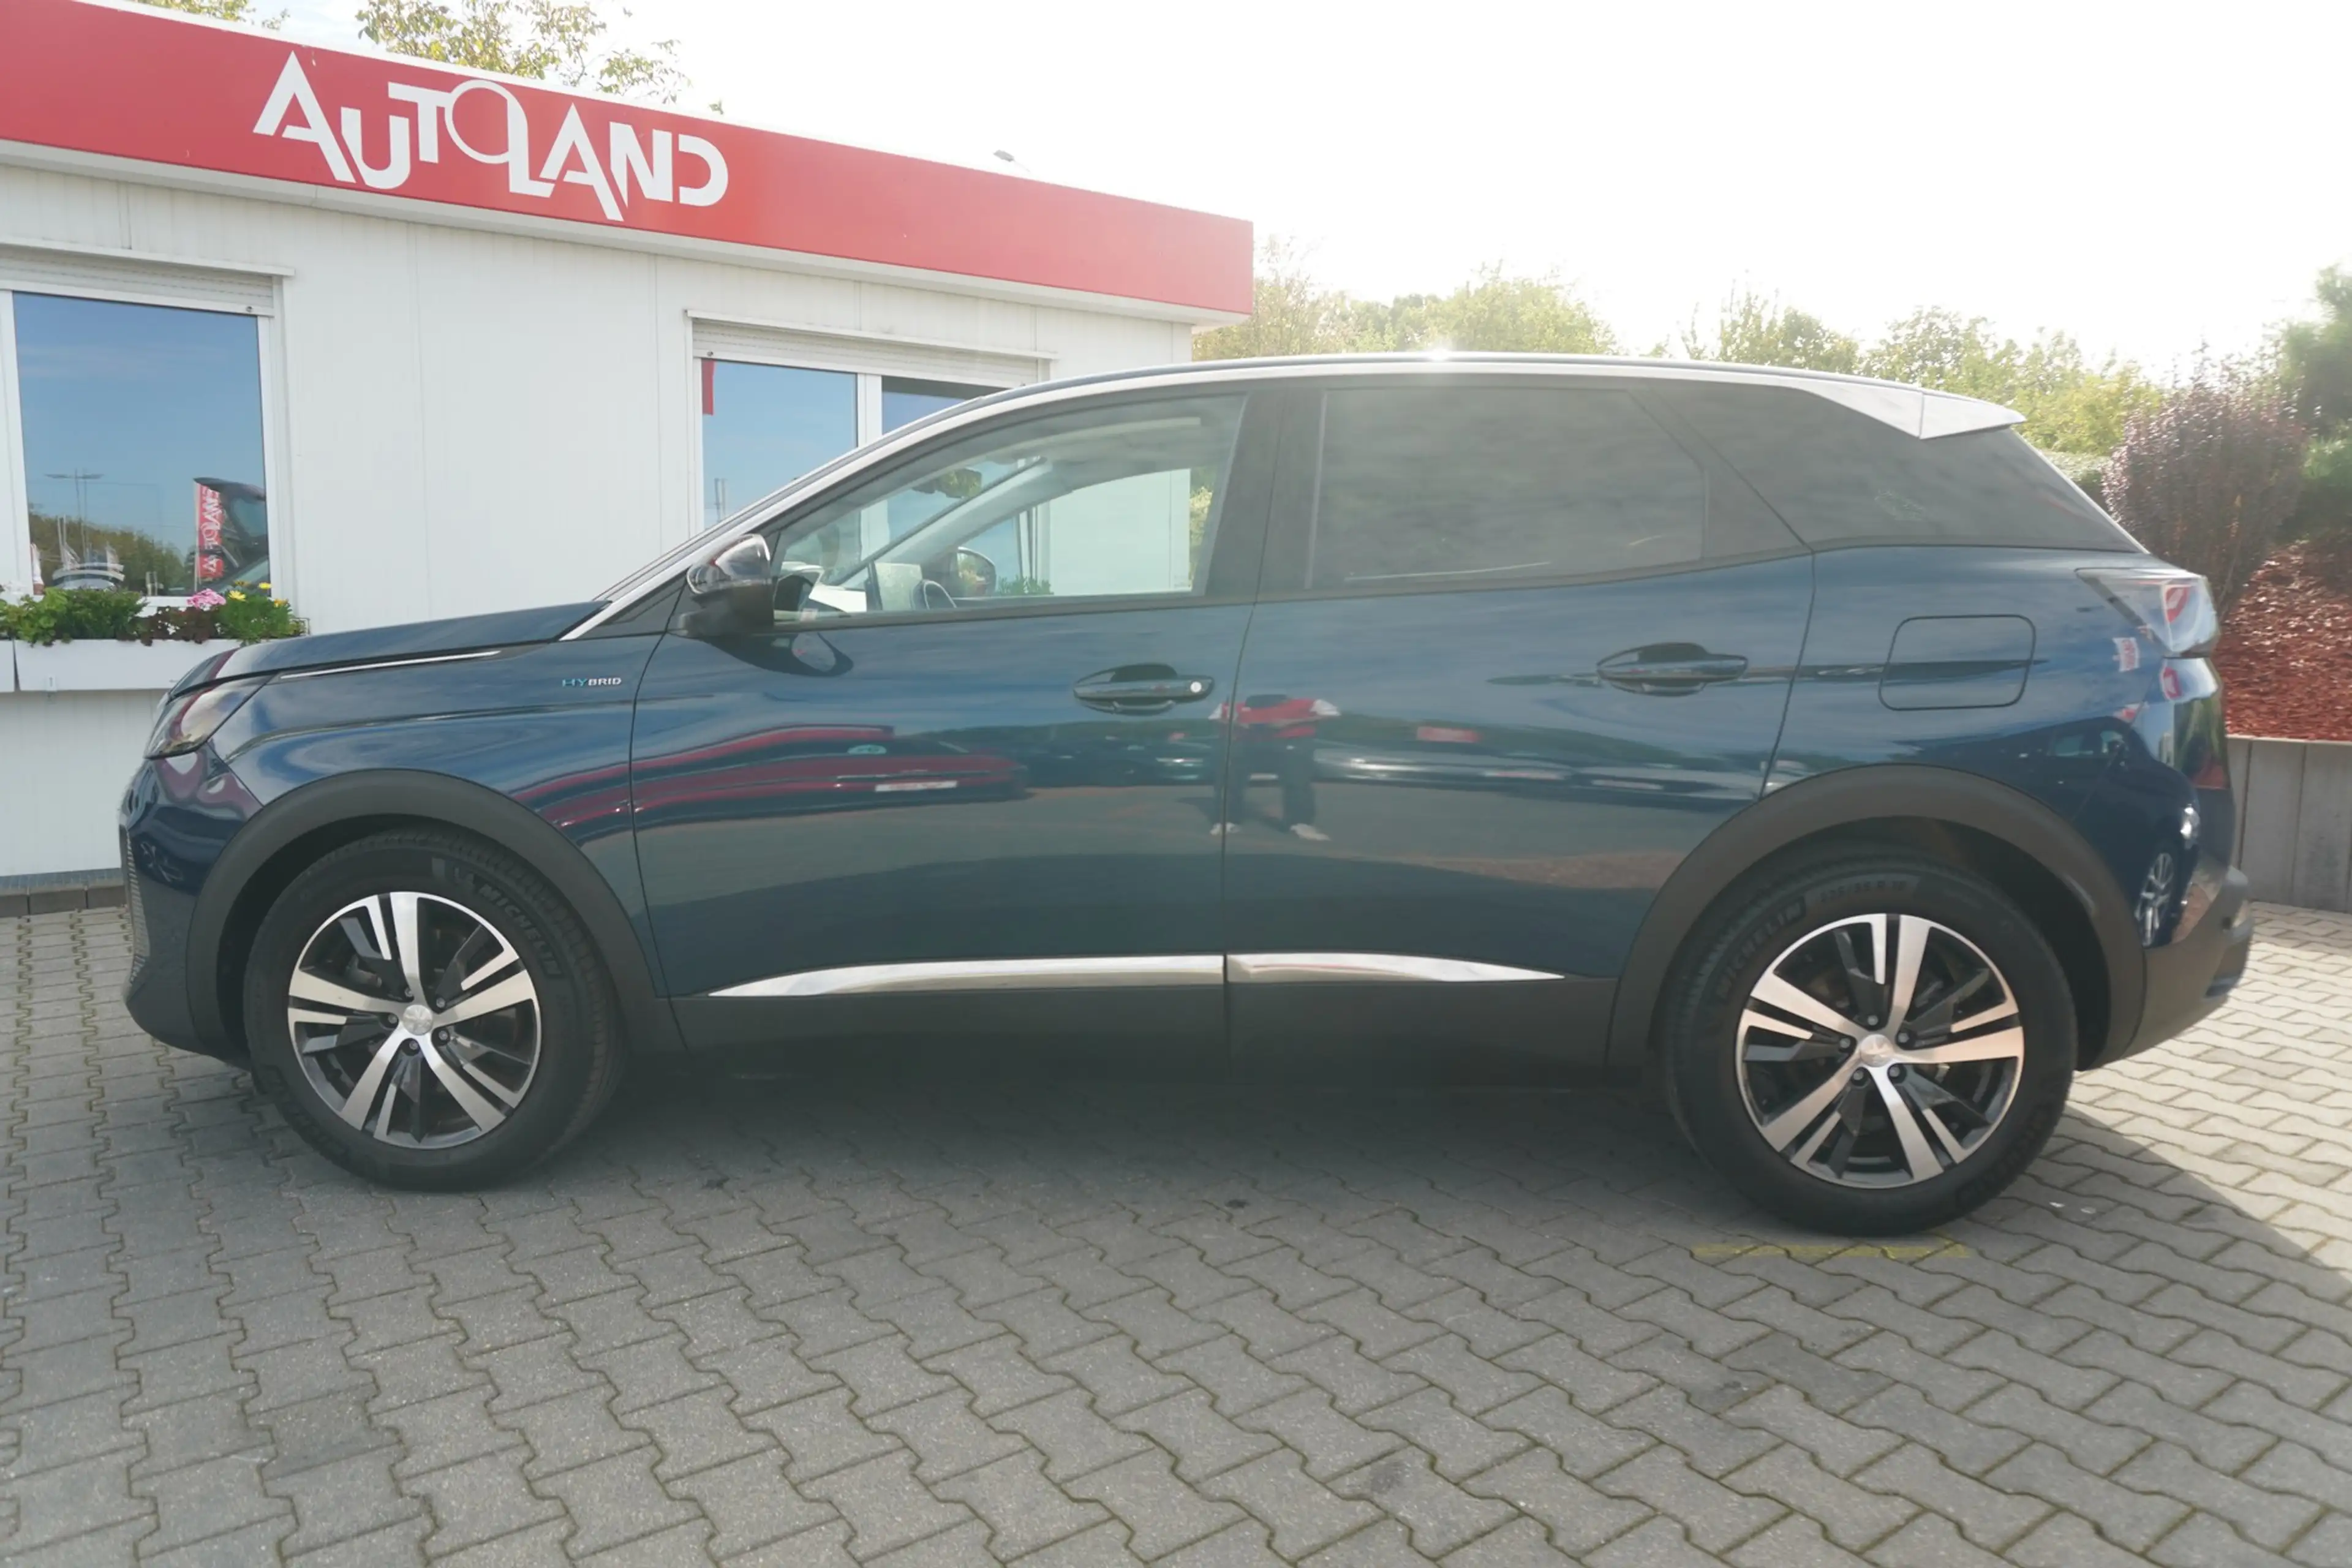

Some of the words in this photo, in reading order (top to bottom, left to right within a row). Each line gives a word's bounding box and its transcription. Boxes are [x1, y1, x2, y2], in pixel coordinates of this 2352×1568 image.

[253, 50, 729, 222] AUTOLAND
[562, 677, 622, 687] HYBRID
[478, 883, 563, 975] MICHELIN
[1716, 901, 1802, 998] MICHELIN
